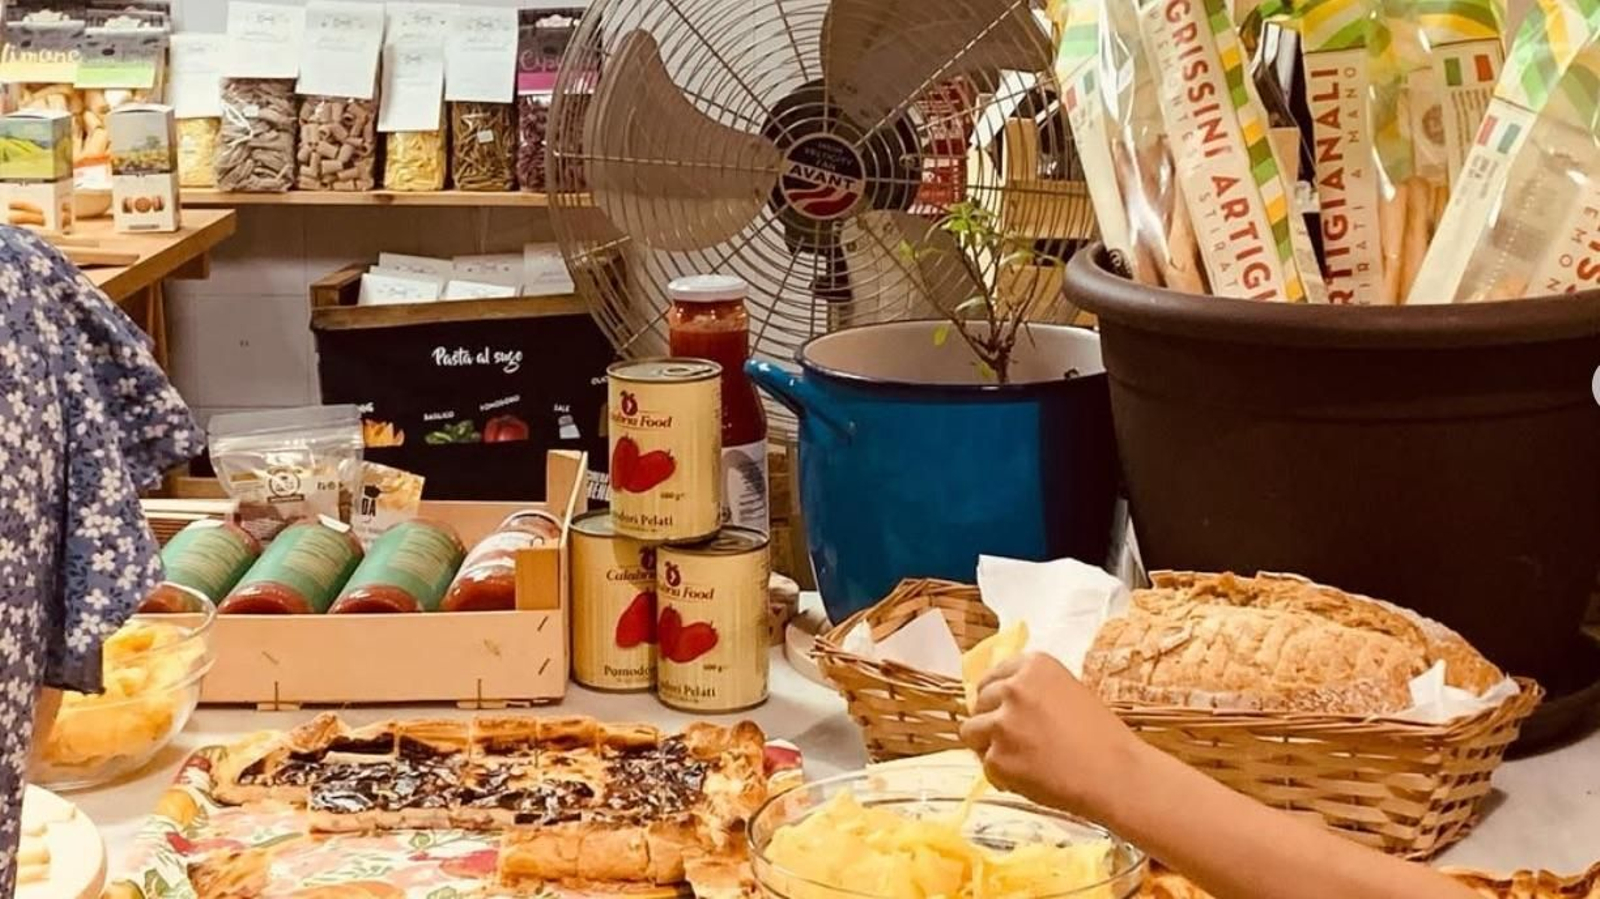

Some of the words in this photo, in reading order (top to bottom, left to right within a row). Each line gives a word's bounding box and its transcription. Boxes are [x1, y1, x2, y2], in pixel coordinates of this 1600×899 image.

[1166, 0, 1232, 157] GRISSINI
[1343, 66, 1360, 143] MANO
[790, 164, 857, 190] AVANT
[431, 346, 473, 367] Pasta
[476, 347, 489, 364] al
[493, 350, 524, 374] sugo
[553, 404, 571, 413] SALE
[640, 415, 673, 428] Food
[641, 514, 674, 527] Pelati
[683, 586, 715, 601] Food
[683, 685, 717, 698] Pelati
